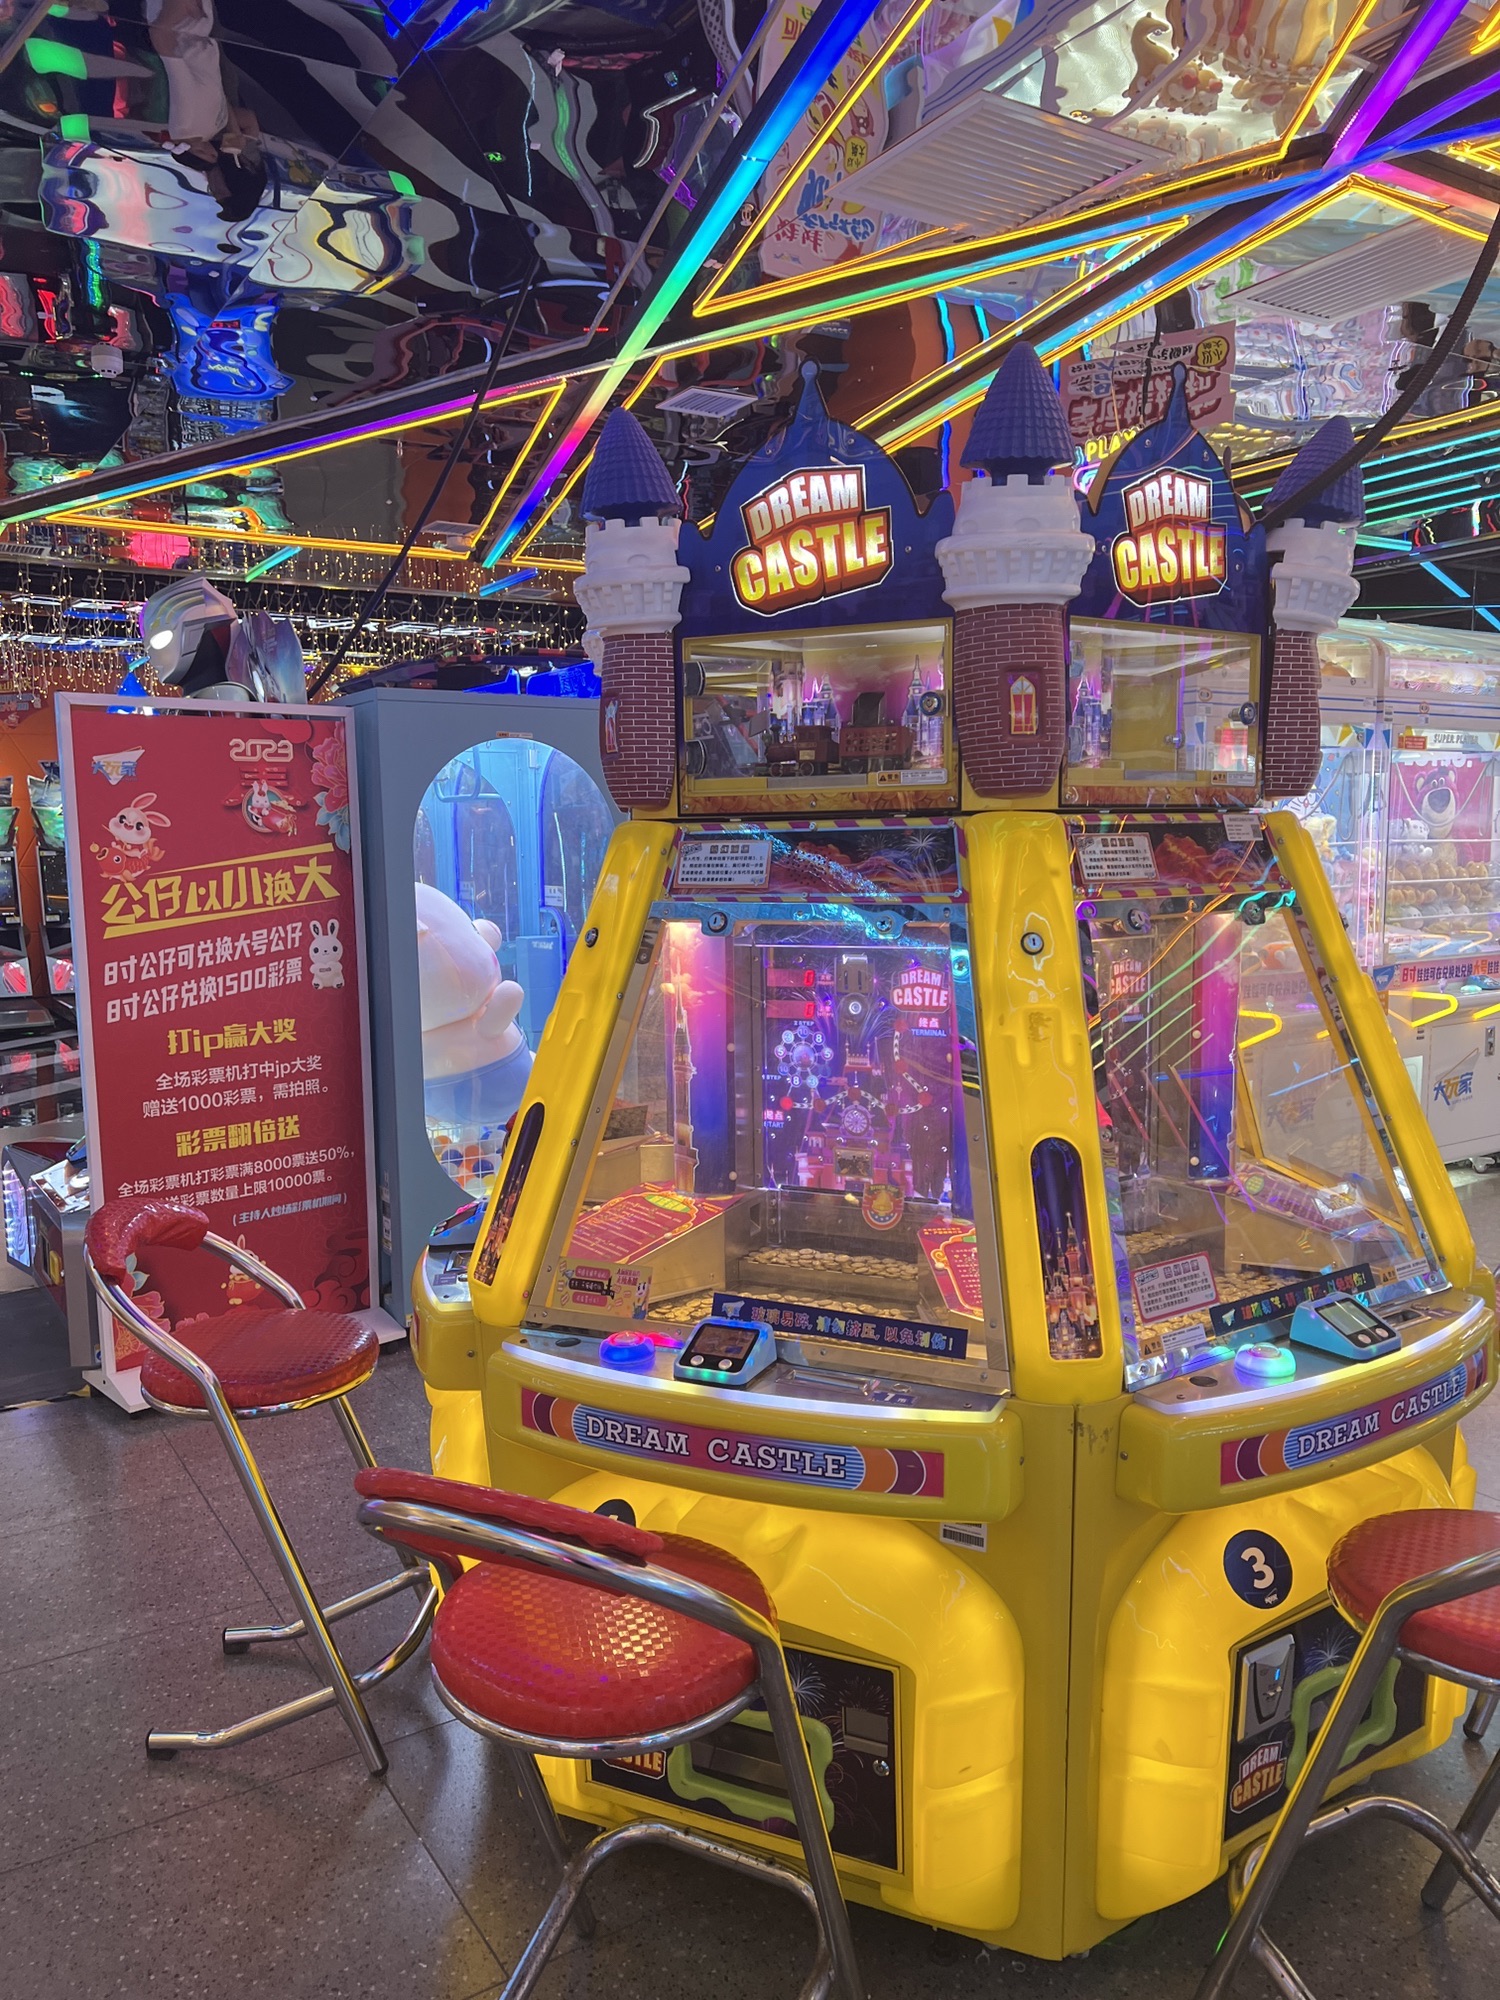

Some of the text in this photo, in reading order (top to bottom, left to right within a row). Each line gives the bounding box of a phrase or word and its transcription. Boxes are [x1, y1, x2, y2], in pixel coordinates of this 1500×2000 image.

[749, 473, 859, 541] DREAM
[1128, 474, 1208, 529] DREAM
[736, 515, 887, 601] CASTLE
[1116, 526, 1223, 589] CASTLE
[229, 738, 294, 763] 2023
[1433, 733, 1455, 744] SUPER
[92, 760, 137, 780] 大玩家
[100, 856, 341, 925] 公仔以小换大
[103, 921, 303, 986] 8寸公仔可兑换大号公仔
[1113, 961, 1142, 974] DREAM
[106, 956, 303, 1024] 8寸公仔兑换1500彩票
[892, 985, 949, 1007] CASTLE
[901, 967, 942, 987] DREAM
[911, 1028, 947, 1037] TERMINAL
[918, 1017, 940, 1029] 终点
[155, 1054, 323, 1091] 全场彩票机打中jp大奖
[1434, 1072, 1474, 1106] 大玩家
[175, 1114, 301, 1158] 彩票翻倍送
[1297, 1374, 1461, 1458] DREAM CASTLE
[586, 1415, 847, 1479] DREAM CASTLE
[1240, 1547, 1275, 1589] 3
[1242, 1746, 1278, 1778] DREAM
[1233, 1763, 1284, 1808] CASTLE
